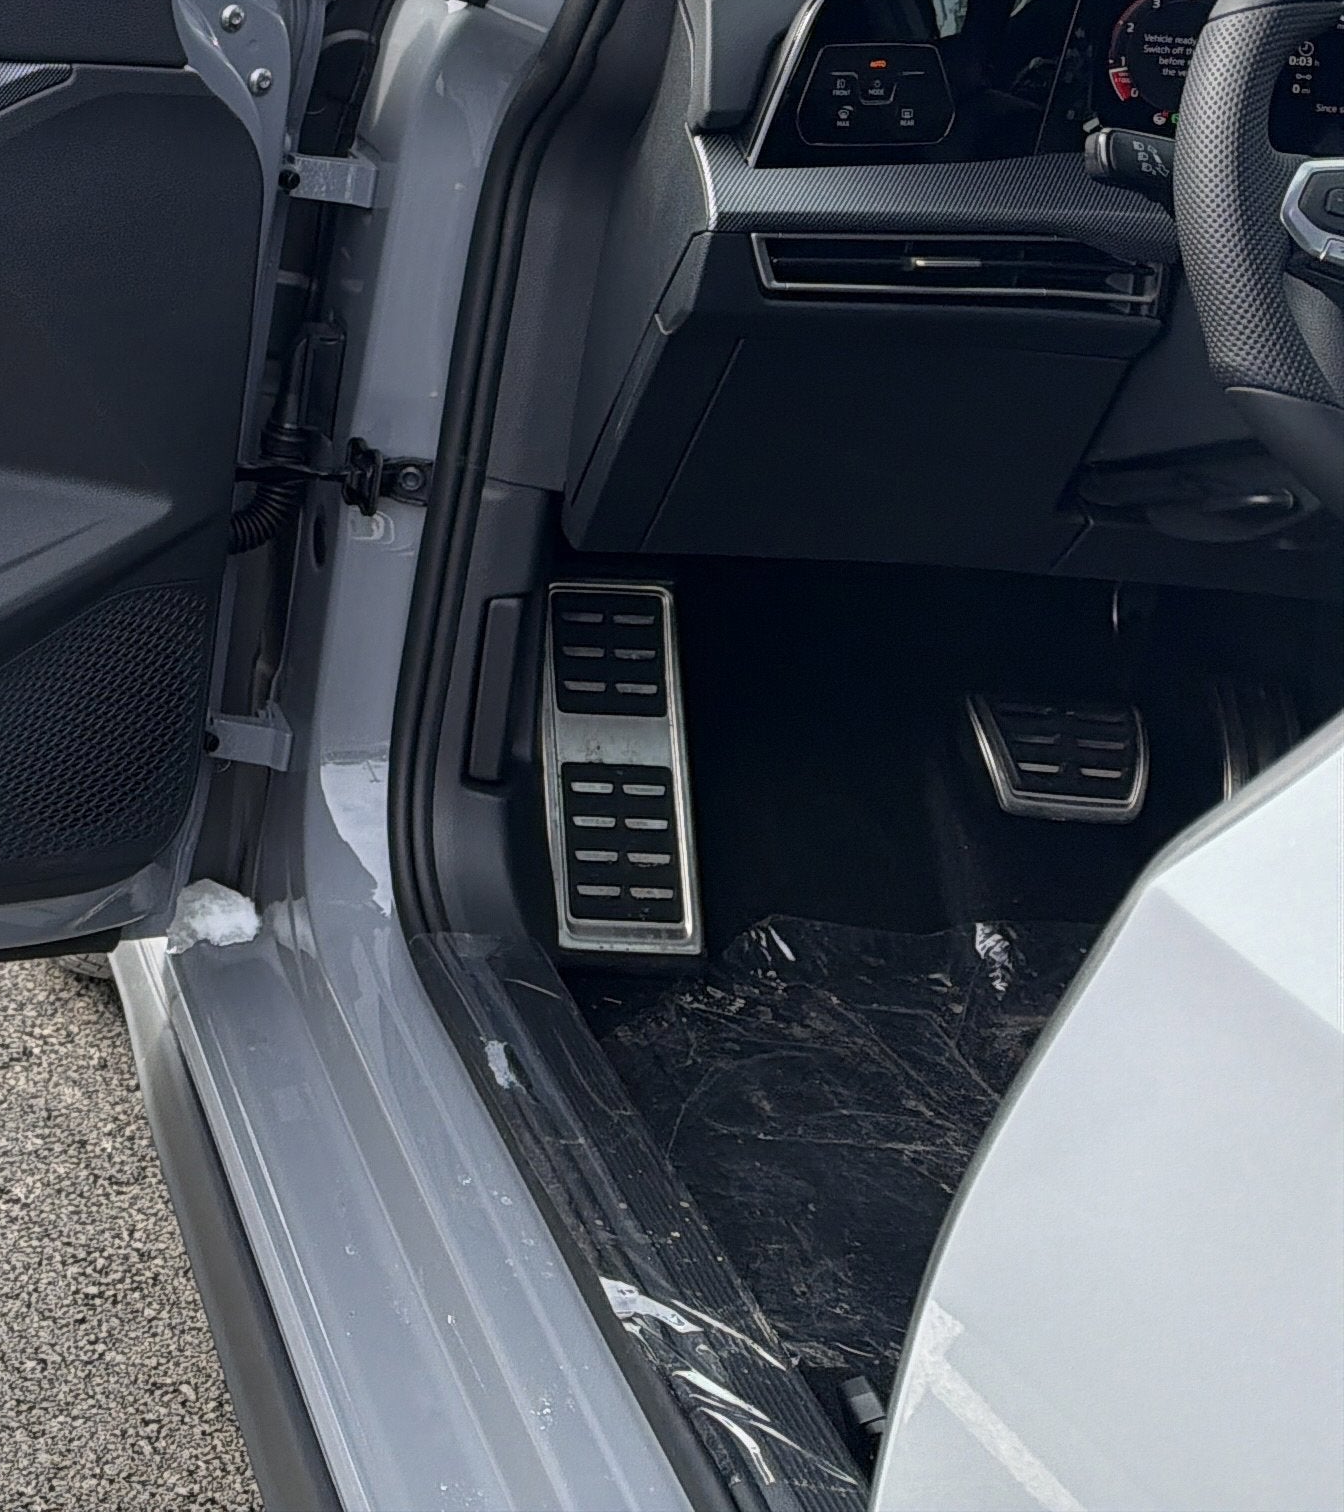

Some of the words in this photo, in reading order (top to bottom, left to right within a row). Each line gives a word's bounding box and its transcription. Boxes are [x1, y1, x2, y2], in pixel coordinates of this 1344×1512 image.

[1153, 0, 1161, 8] 3
[1127, 23, 1135, 32] 2
[1144, 34, 1173, 43] Vehicle
[1143, 45, 1170, 54] Switch
[1172, 46, 1184, 55] off
[1158, 56, 1185, 66] before
[1289, 56, 1312, 66] 0:03
[1162, 68, 1177, 77] the
[868, 88, 884, 96] MODE
[1131, 88, 1138, 97] 0
[1292, 84, 1300, 94] 0
[1316, 104, 1337, 113] Since
